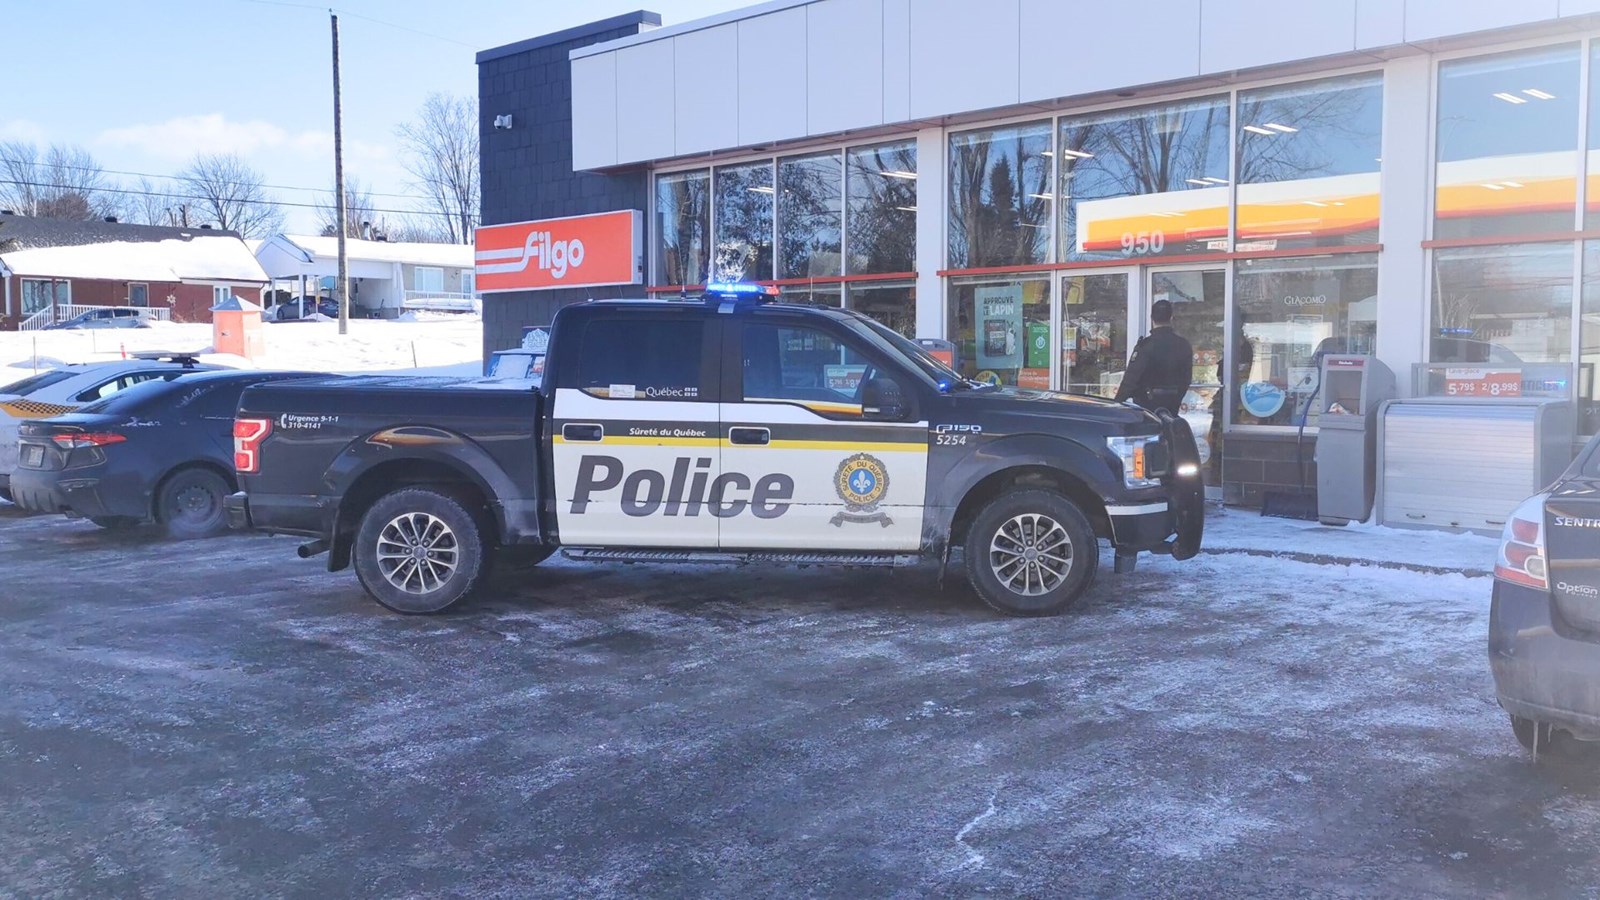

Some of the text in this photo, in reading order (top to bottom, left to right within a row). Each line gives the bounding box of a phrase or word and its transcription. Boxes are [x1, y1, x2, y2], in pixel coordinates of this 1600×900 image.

[1120, 229, 1165, 255] 950
[522, 231, 585, 279] filgo
[1284, 294, 1327, 306] GIACOMO
[990, 304, 1014, 316] LAPIN
[646, 386, 683, 397] Québec
[1448, 383, 1475, 395] 5.79$
[288, 415, 320, 423] Urgence
[629, 427, 706, 437] Sûreté du Québec
[936, 435, 966, 445] 5254
[569, 455, 795, 519] Police
[848, 492, 876, 502] POLICE
[1556, 581, 1598, 595] Option
